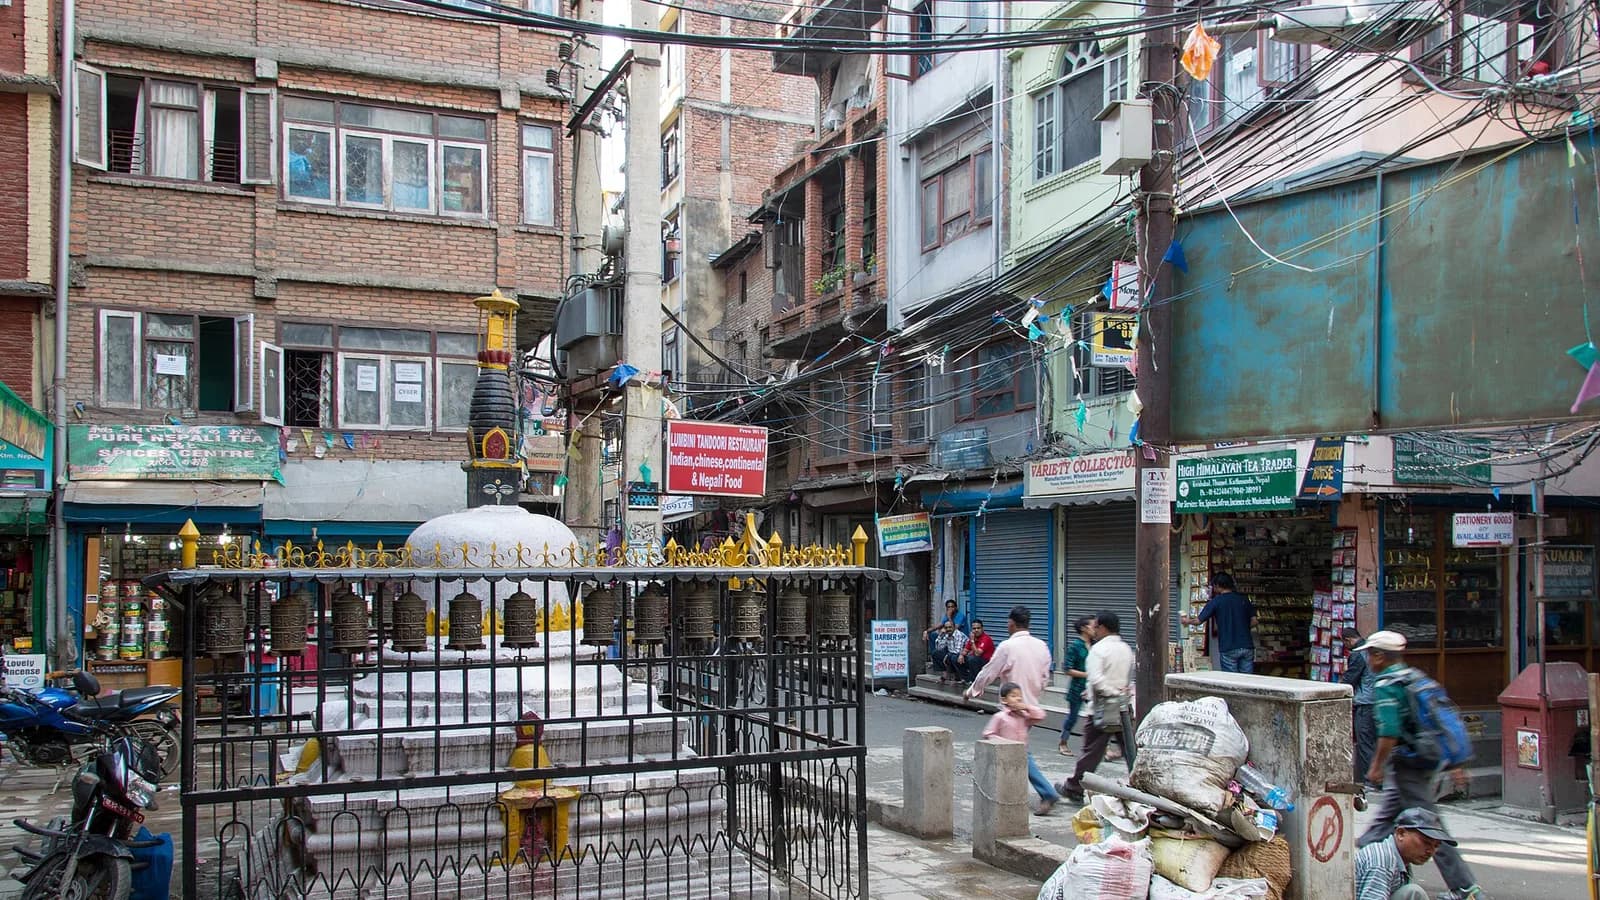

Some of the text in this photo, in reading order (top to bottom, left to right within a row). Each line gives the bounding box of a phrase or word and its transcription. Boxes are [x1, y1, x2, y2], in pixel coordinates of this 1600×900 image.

[88, 433, 264, 443] PURE NEPALI TEA
[670, 432, 766, 453] LUMBINI TANDOORI RESTAURANT
[171, 441, 185, 449] &
[97, 449, 255, 458] SPICES CENTRE
[1031, 459, 1071, 477] VARIETY
[1177, 464, 1195, 477] HIGH
[1196, 461, 1242, 476] HIMALAYAN
[1244, 458, 1258, 472] TEA
[1103, 469, 1125, 477] Exporter
[691, 471, 743, 490] & Nepali Food
[1255, 474, 1270, 485] Nepal
[1455, 515, 1513, 525] STATIONERY GOODS
[1456, 532, 1490, 540] AVAILABLE
[1194, 716, 1215, 728] DATE
